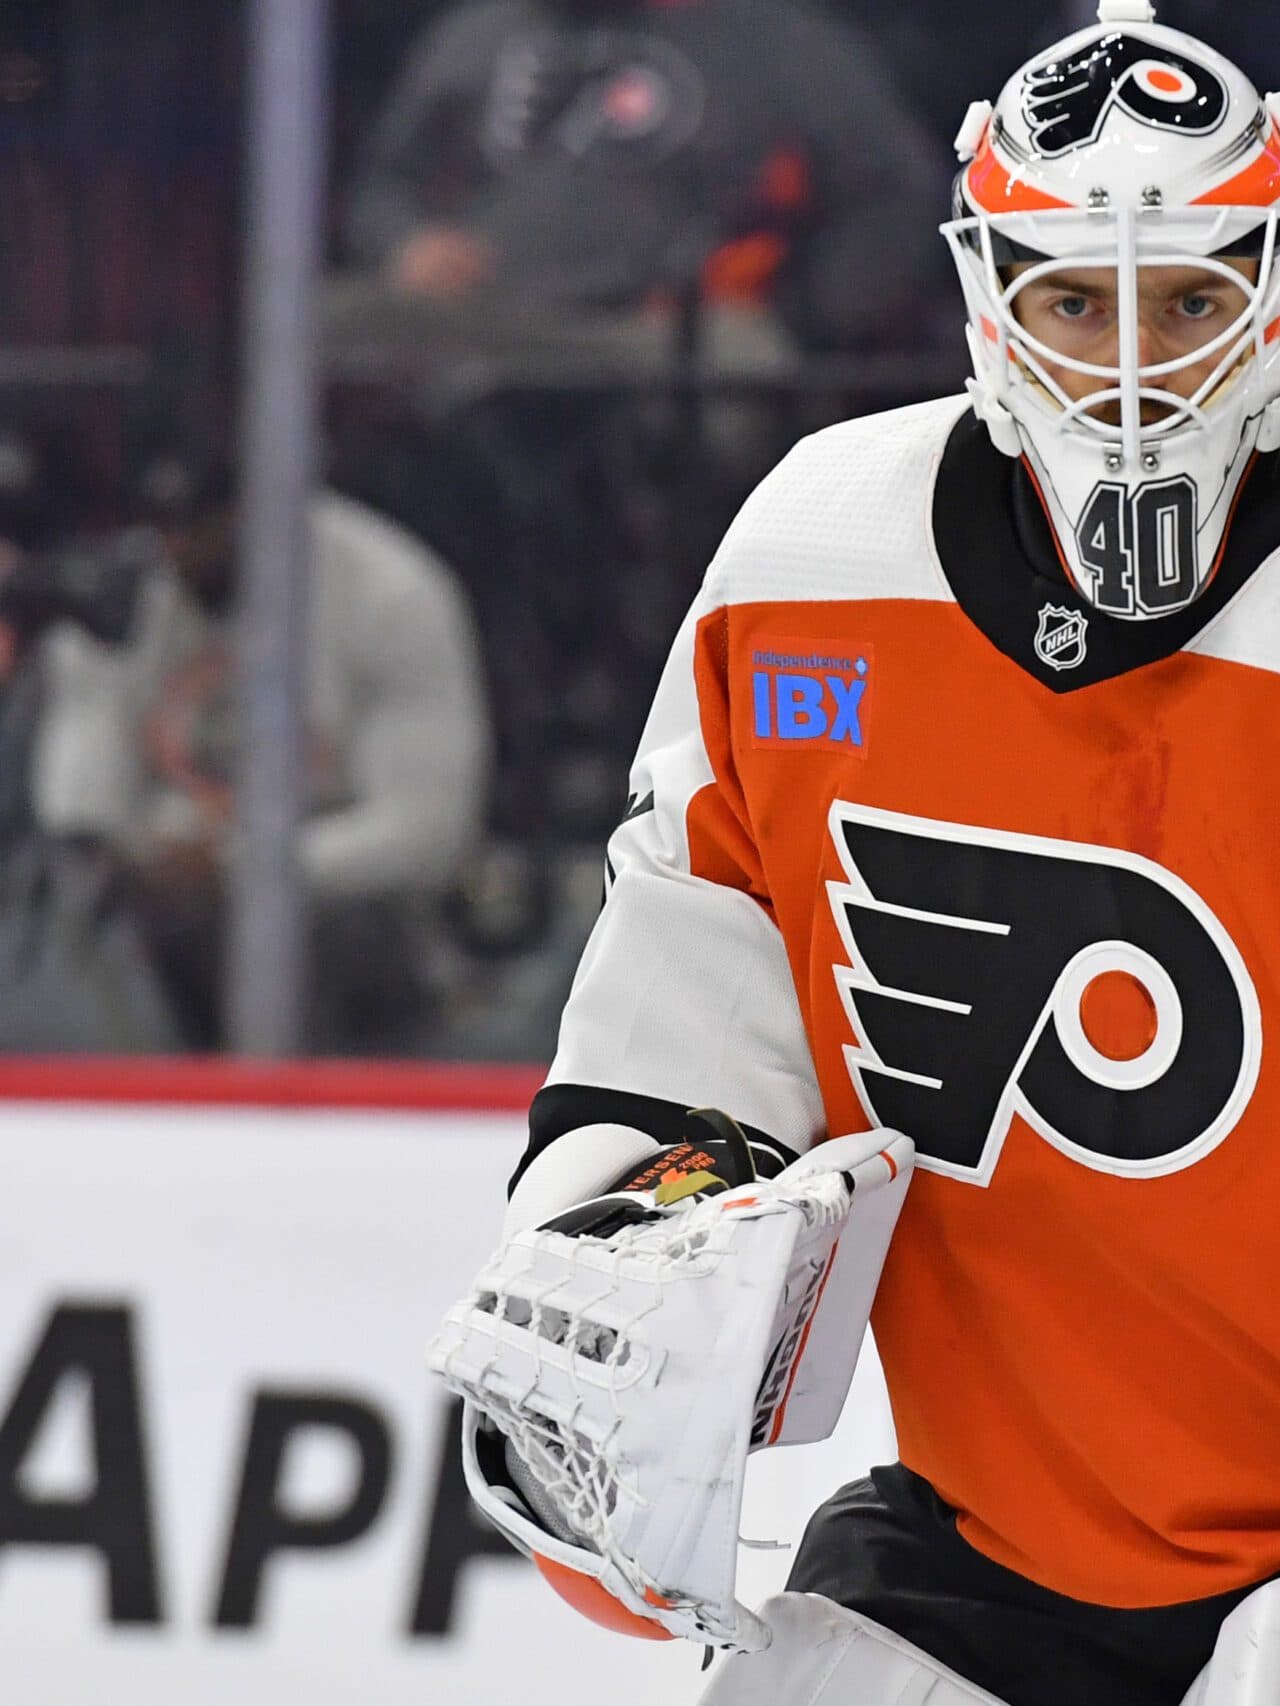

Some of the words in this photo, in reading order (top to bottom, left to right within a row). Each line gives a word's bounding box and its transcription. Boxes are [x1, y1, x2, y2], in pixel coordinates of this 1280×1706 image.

[1074, 473, 1200, 615] 40
[1044, 624, 1077, 653] NHL
[753, 671, 867, 746] IBX
